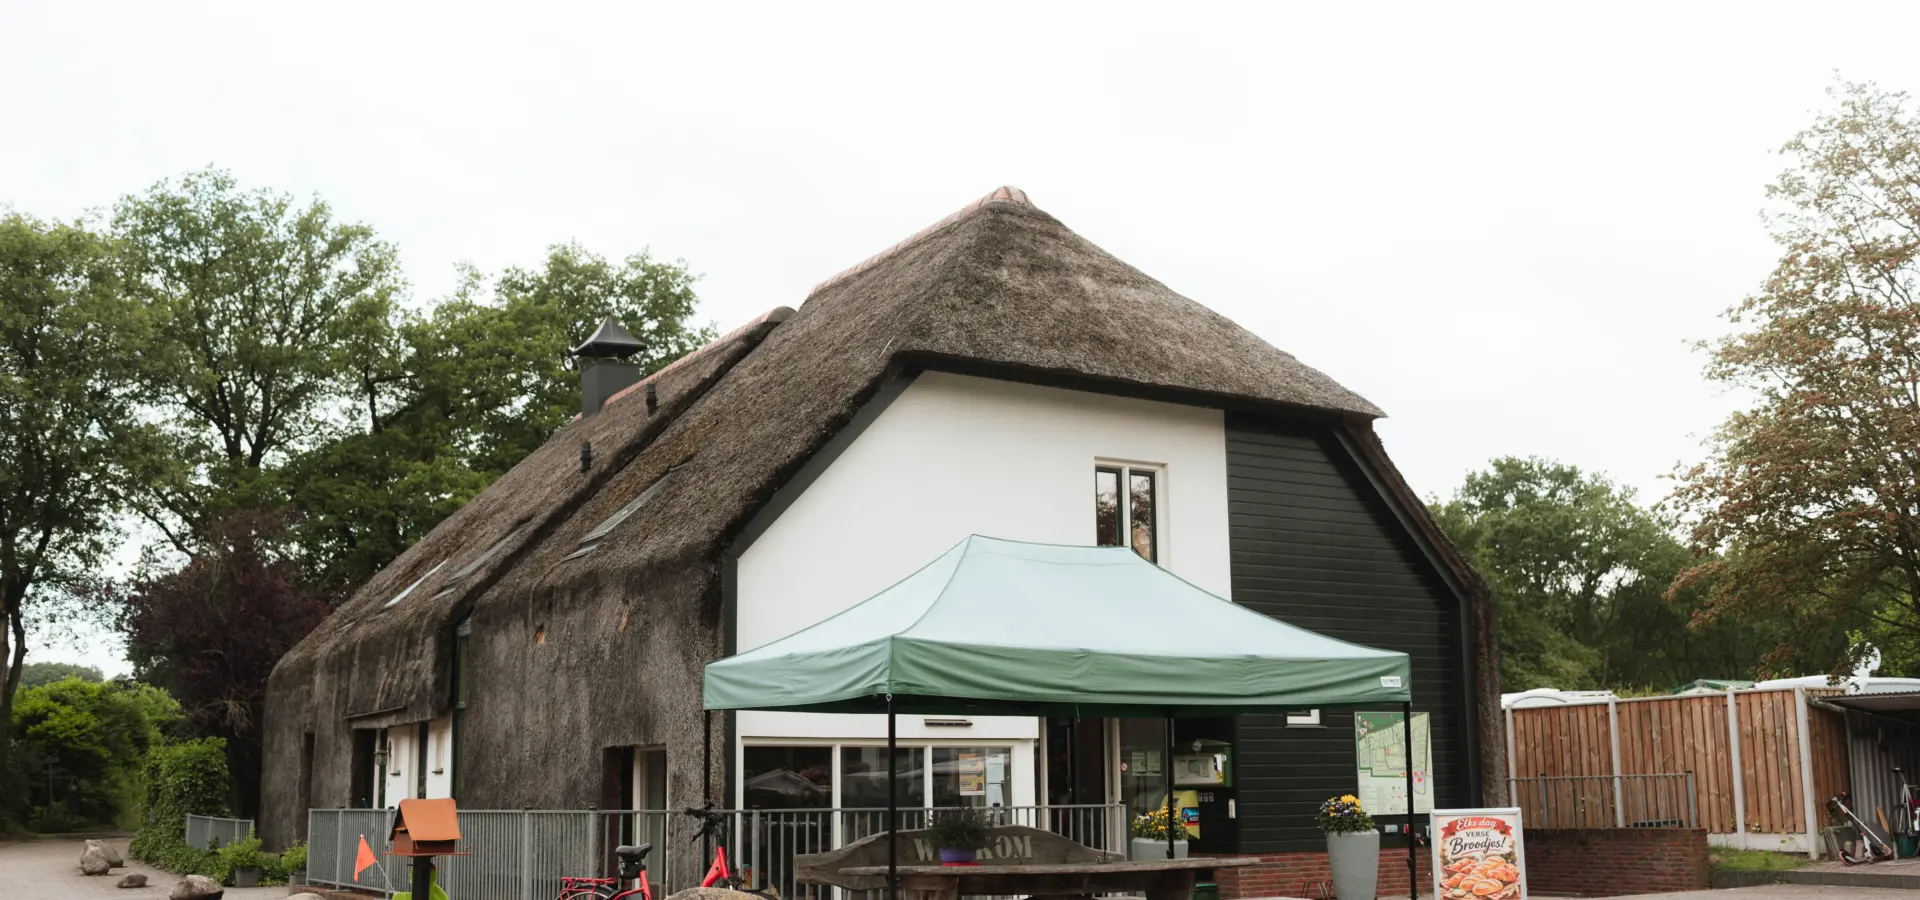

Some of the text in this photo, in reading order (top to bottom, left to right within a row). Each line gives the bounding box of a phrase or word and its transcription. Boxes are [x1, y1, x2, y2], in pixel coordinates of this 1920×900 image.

[1456, 817, 1497, 830] Elke dag
[1450, 836, 1506, 855] Broodjes!
